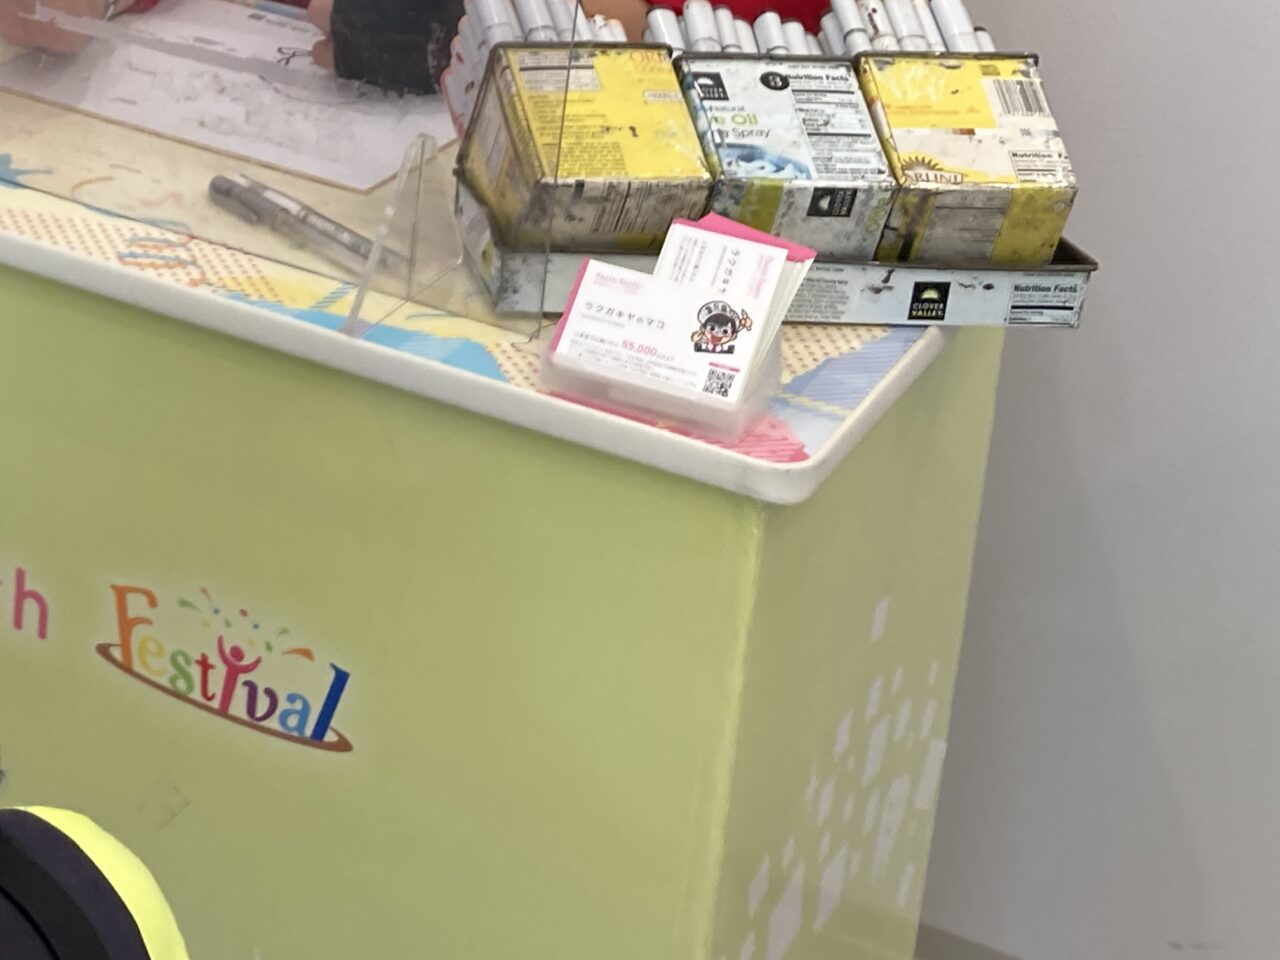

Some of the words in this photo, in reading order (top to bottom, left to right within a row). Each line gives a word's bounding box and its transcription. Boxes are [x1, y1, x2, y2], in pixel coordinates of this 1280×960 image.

[732, 127, 770, 138] Spray
[913, 302, 945, 310] CLOVER
[110, 583, 351, 742] Festival
